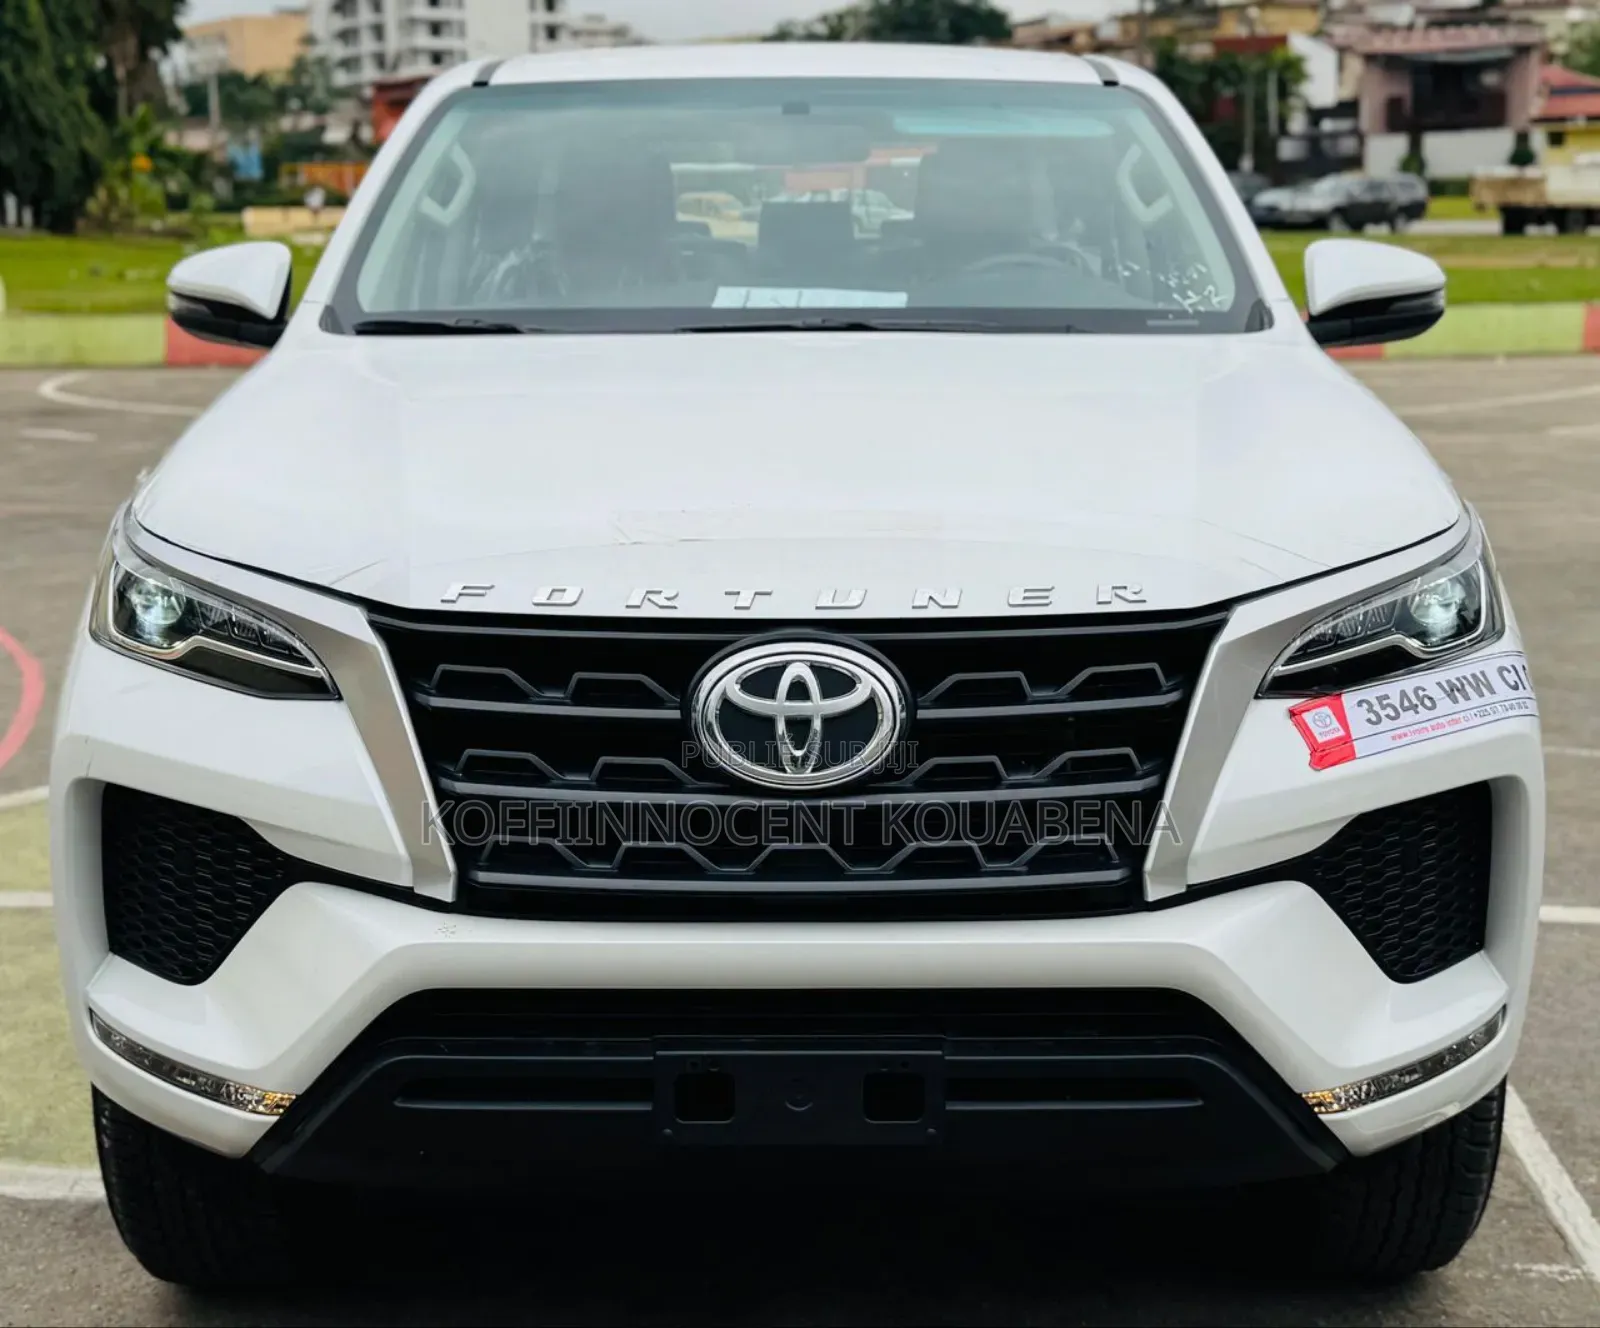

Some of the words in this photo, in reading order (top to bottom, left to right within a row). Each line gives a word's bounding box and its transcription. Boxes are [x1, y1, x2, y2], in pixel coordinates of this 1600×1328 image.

[440, 582, 1148, 609] FORTUNER
[1356, 685, 1437, 725] 3546
[1435, 669, 1497, 705] WW
